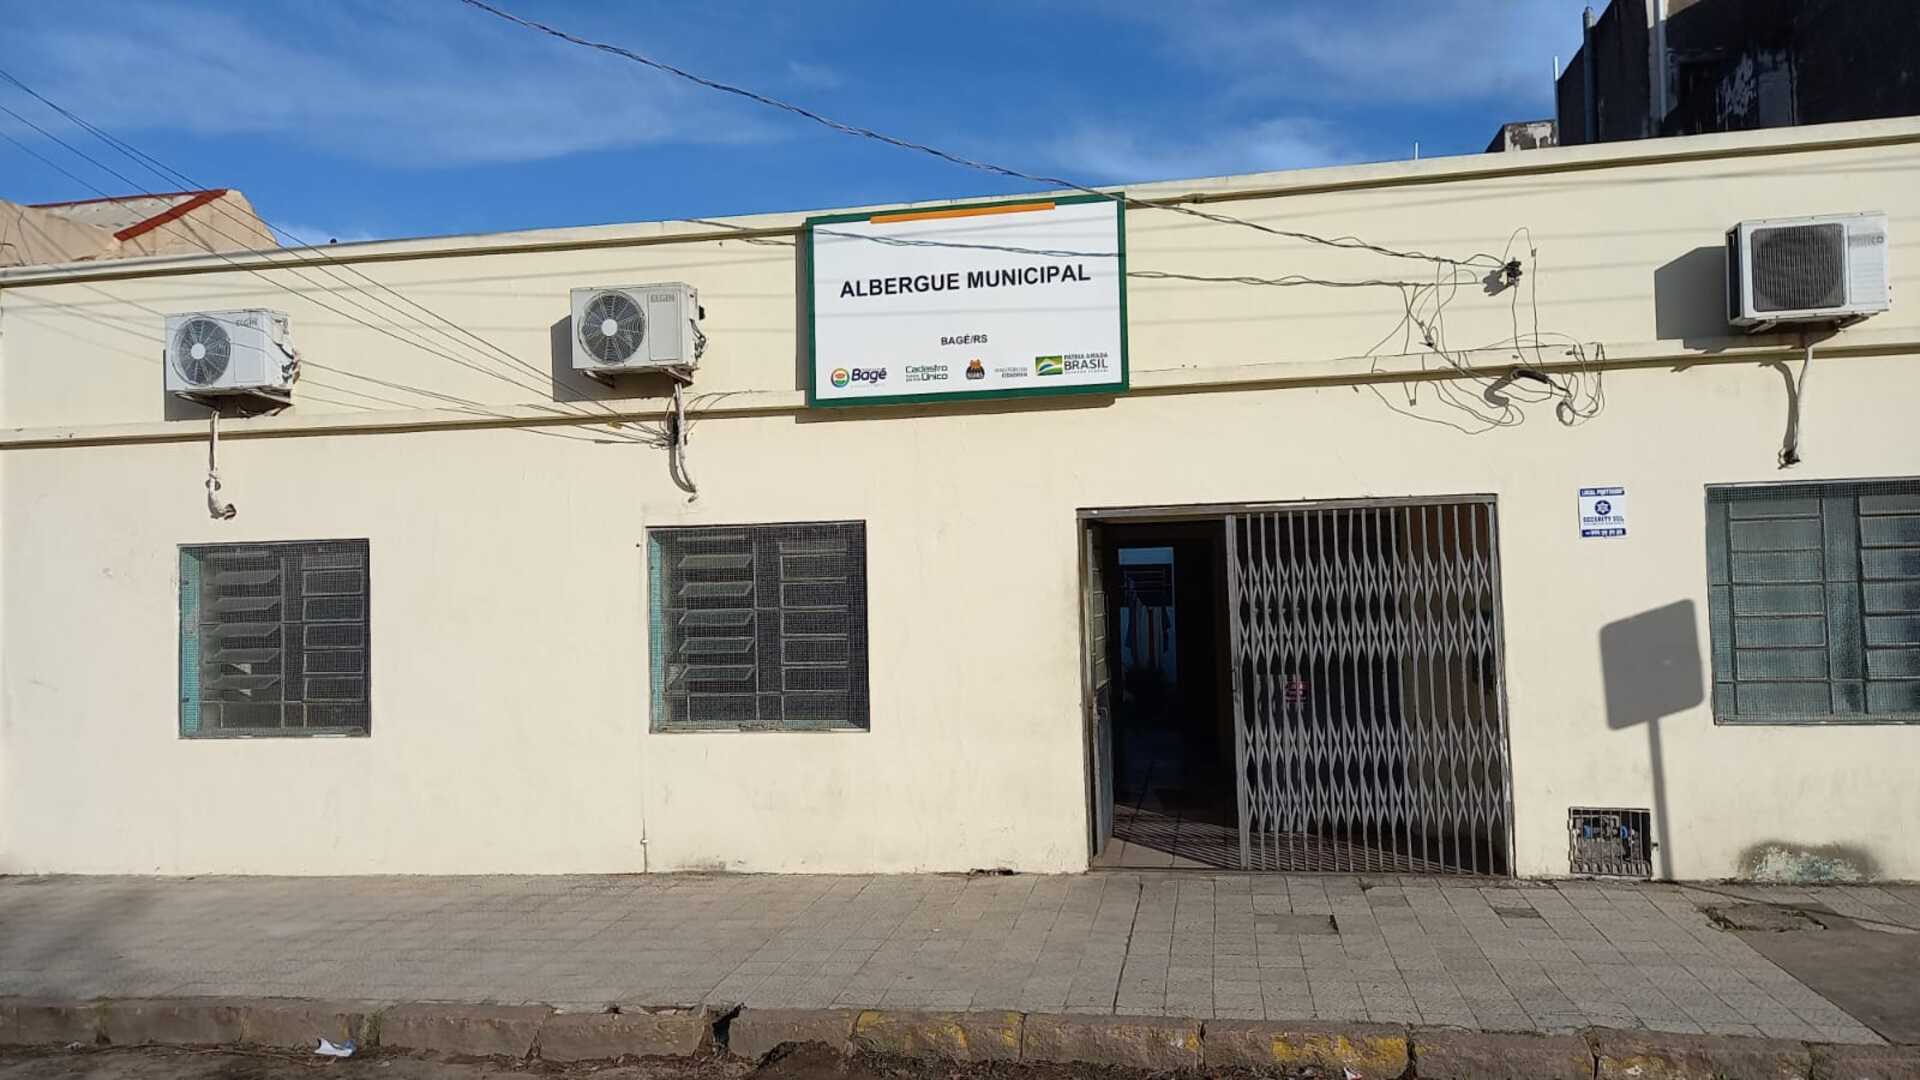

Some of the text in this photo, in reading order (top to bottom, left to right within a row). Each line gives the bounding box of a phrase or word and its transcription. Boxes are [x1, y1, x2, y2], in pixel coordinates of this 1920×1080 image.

[840, 264, 1091, 298] ALBERGUE MUNICIPAL
[940, 333, 988, 346] BAGÉ/RS
[905, 364, 948, 374] Cadastro
[1063, 359, 1109, 371] BRASIL
[851, 367, 887, 384] Bagé
[921, 372, 948, 381] Único
